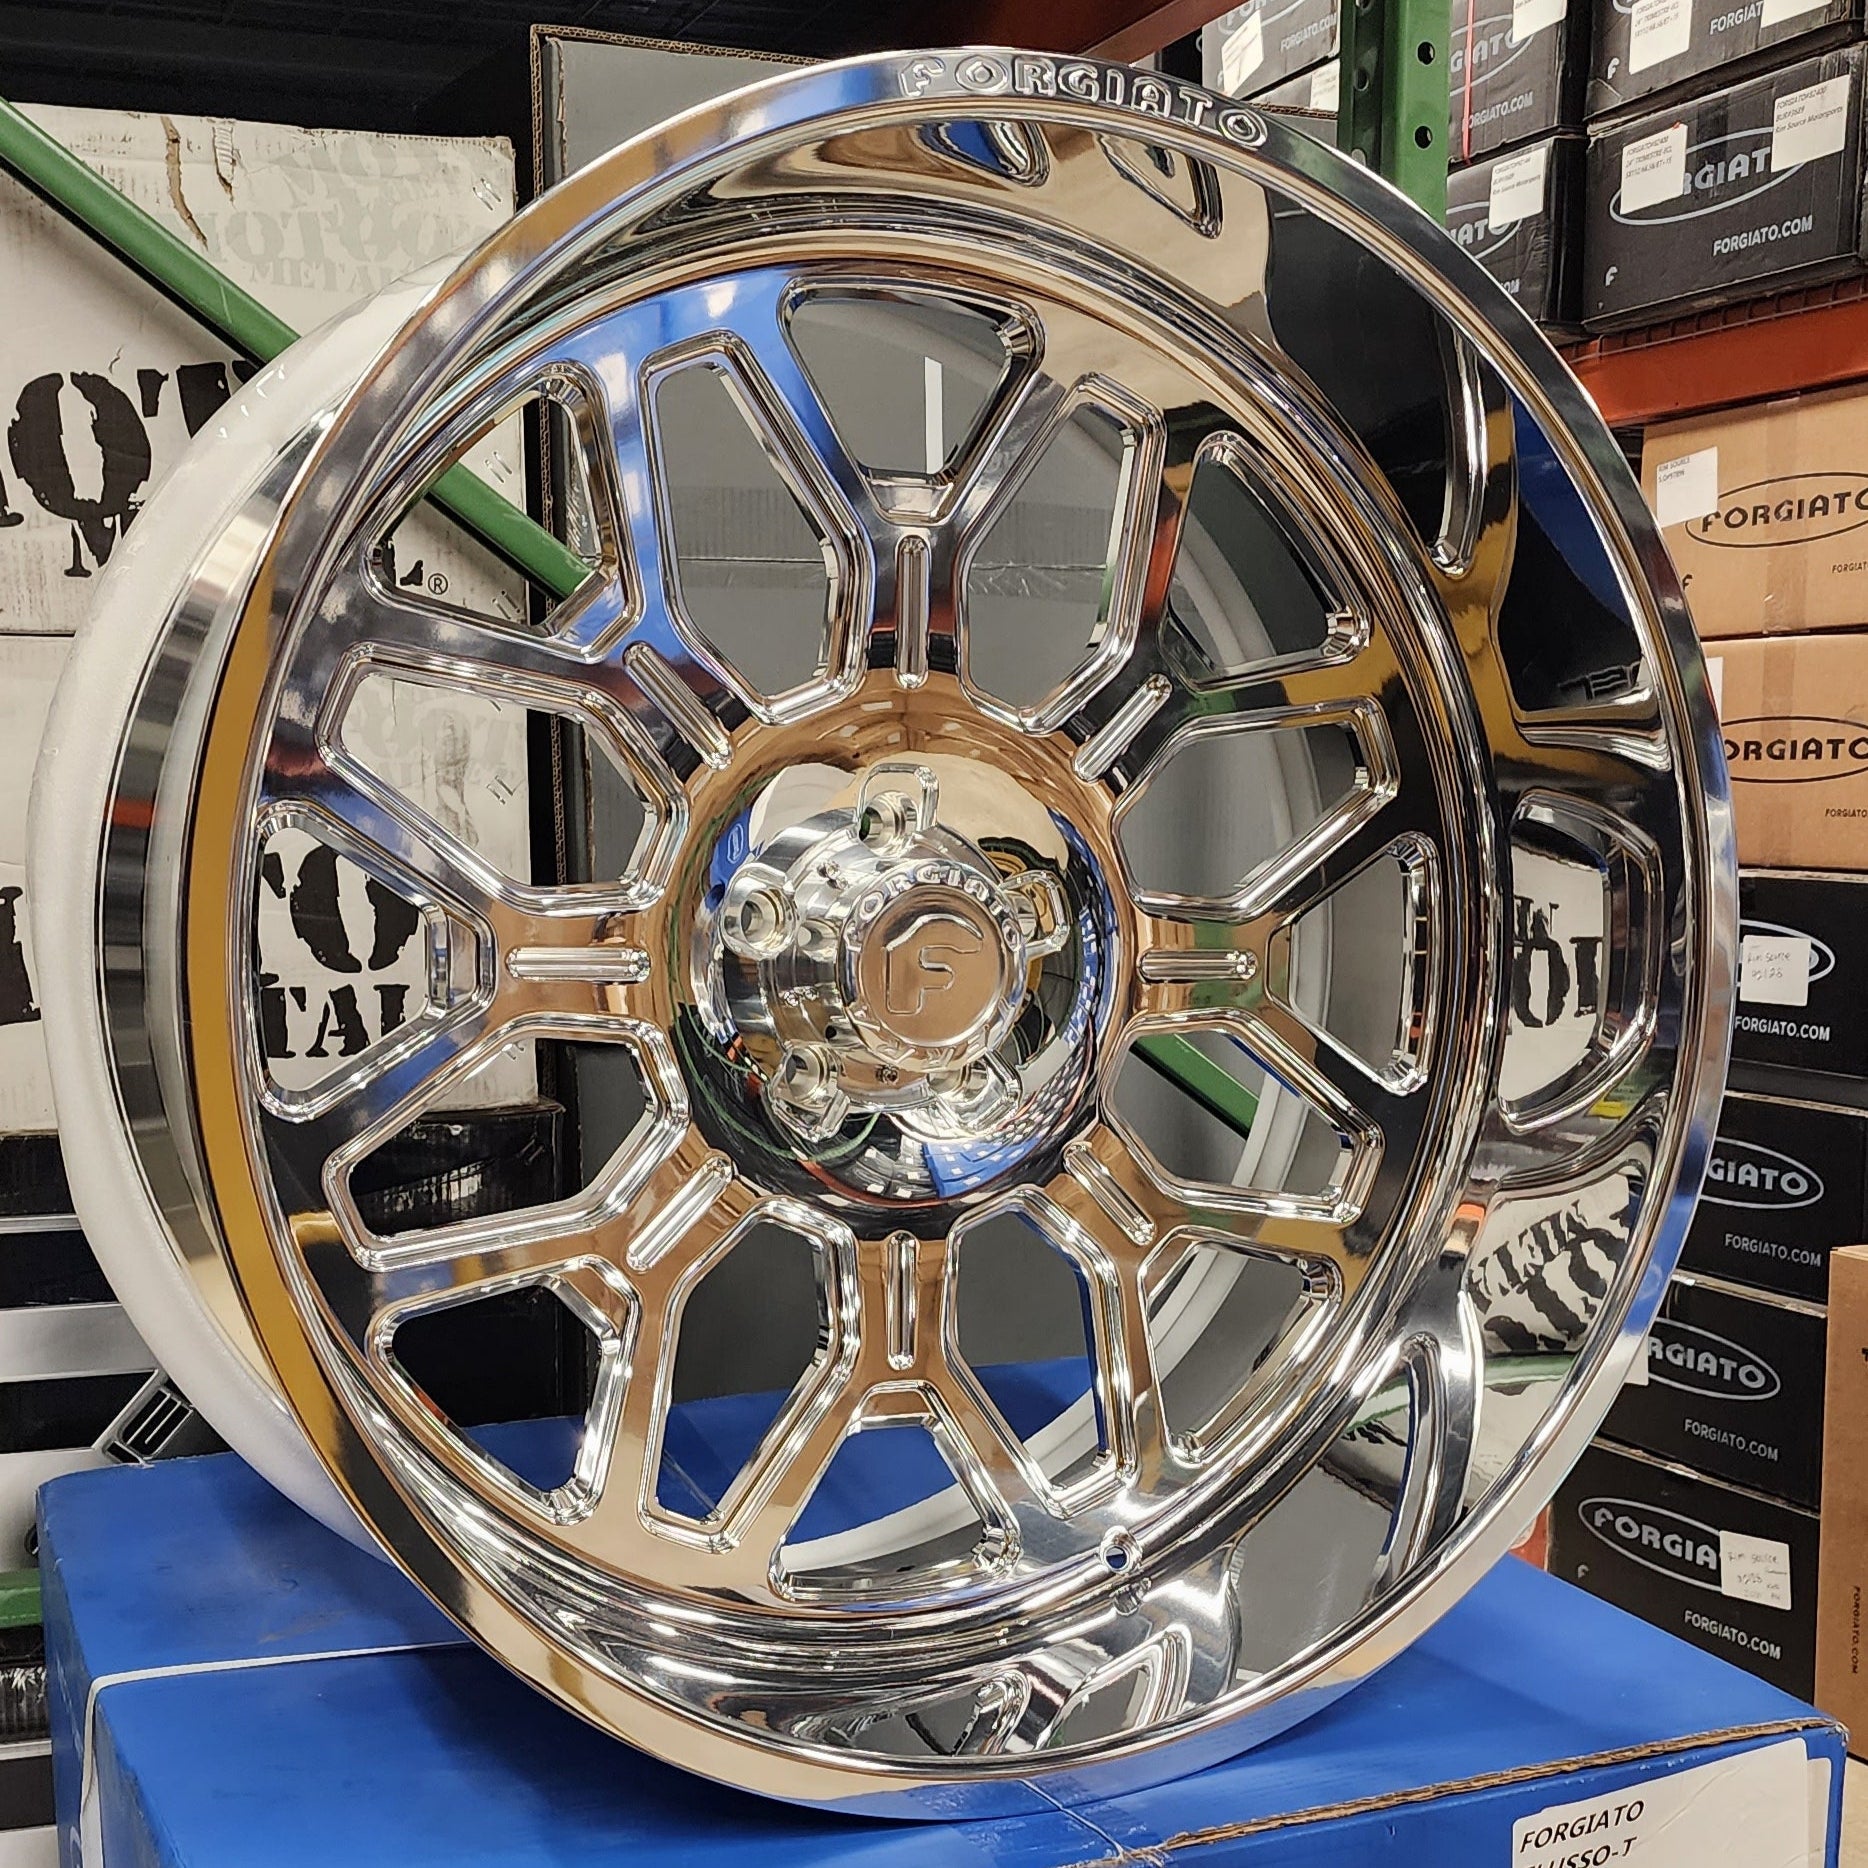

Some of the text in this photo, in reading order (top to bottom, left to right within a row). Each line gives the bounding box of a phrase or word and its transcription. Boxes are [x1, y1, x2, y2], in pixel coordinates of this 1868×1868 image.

[900, 55, 1268, 147] FORGIATO
[1713, 215, 1813, 256] FORGIATO.COM
[1605, 266, 1618, 286] F
[1735, 1016, 1830, 1041] FORGIATO.COM
[1725, 1234, 1821, 1267] FORGIATO.COM
[1684, 1419, 1778, 1461] FORGIATO.COM
[1684, 1610, 1781, 1659] FORGIATO.COM
[1520, 1800, 1644, 1853] FORGIATO
